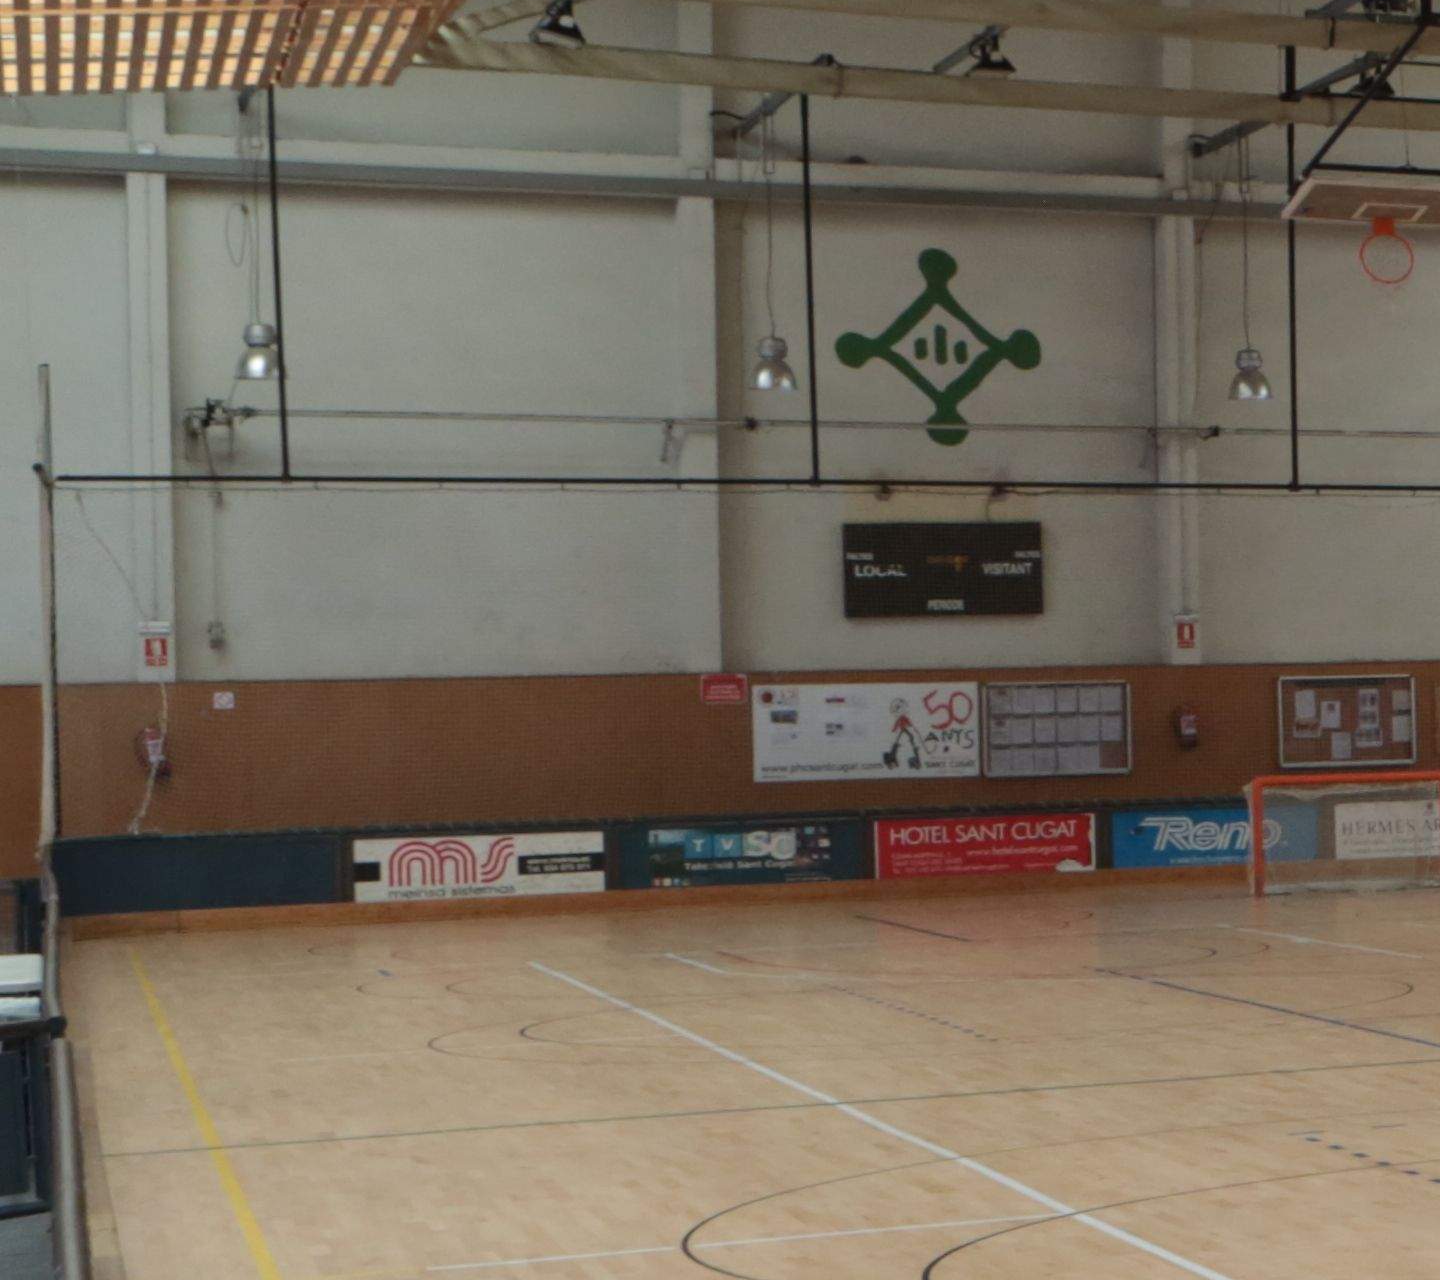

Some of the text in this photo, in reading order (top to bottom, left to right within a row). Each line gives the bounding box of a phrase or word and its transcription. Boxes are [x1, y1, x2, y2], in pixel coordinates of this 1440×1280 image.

[982, 563, 1032, 575] VISITANT
[923, 690, 973, 730] 50
[889, 820, 1077, 846] HOTEL SANT CUGAT
[1139, 816, 1282, 851] Reno
